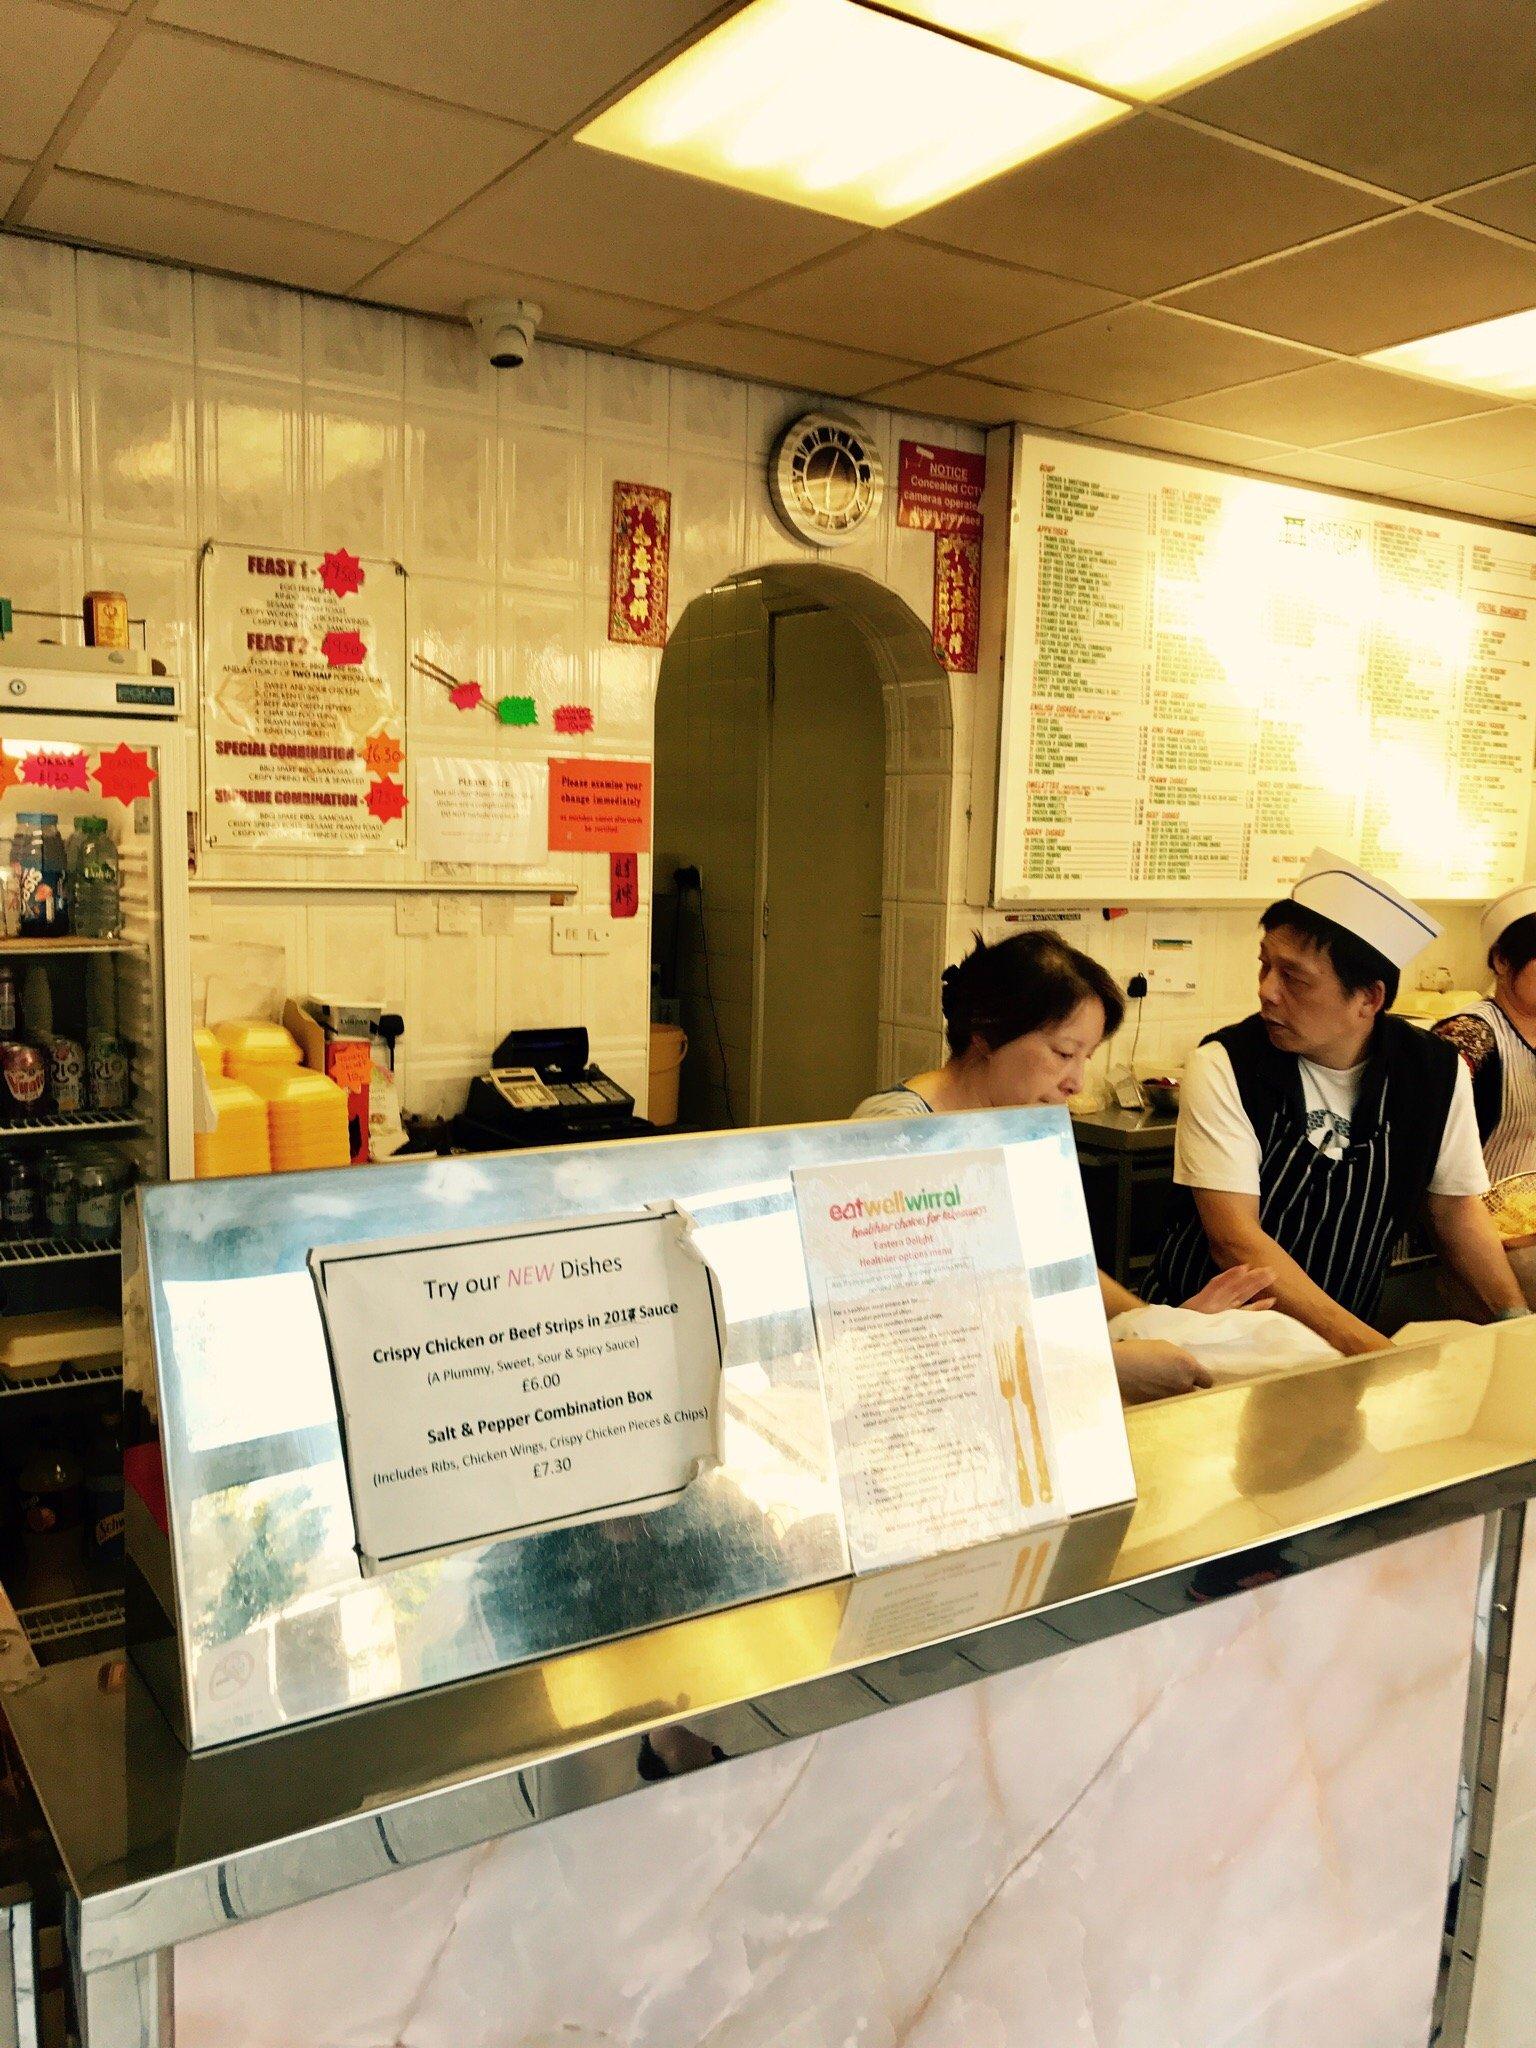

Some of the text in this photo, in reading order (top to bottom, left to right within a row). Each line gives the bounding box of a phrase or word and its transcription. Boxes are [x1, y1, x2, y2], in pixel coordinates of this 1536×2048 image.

[930, 463, 968, 480] NOTICE
[911, 475, 958, 493] Concealed
[904, 491, 942, 505] cameras
[248, 555, 307, 579] FEAST 1
[247, 632, 309, 655] FEAST 2
[292, 671, 311, 679] TWO
[312, 672, 332, 681] HALF
[215, 740, 355, 762] SPECIAL COMBINATION
[458, 777, 487, 787] PLESE
[561, 775, 642, 791] Please examine your
[274, 790, 358, 808] COMBINATION
[561, 793, 641, 808] change immediately
[852, 1221, 895, 1239] healthier
[926, 1211, 940, 1226] for
[873, 1233, 935, 1251] Eastern Delight
[859, 1247, 953, 1268] Healthier options menu
[423, 1255, 623, 1301] Try our NEW Dishes
[373, 1343, 421, 1366] Crispy
[425, 1332, 485, 1355] Chicken
[489, 1330, 505, 1343] or
[509, 1322, 542, 1341] Beef
[545, 1315, 584, 1337] Strips
[587, 1313, 600, 1327] in
[639, 1301, 679, 1319] Sauce
[427, 1335, 640, 1386] (A Plummy, Sweet, Sour & Spicy Sauce)
[522, 1373, 561, 1394] £6.00
[427, 1388, 654, 1445] Salt & Pepper Combination Box
[373, 1406, 709, 1488] (Includes Ribs, Chicken Wings, Crispy Chicken Pieces & Chips)
[533, 1456, 573, 1480] £7.30
